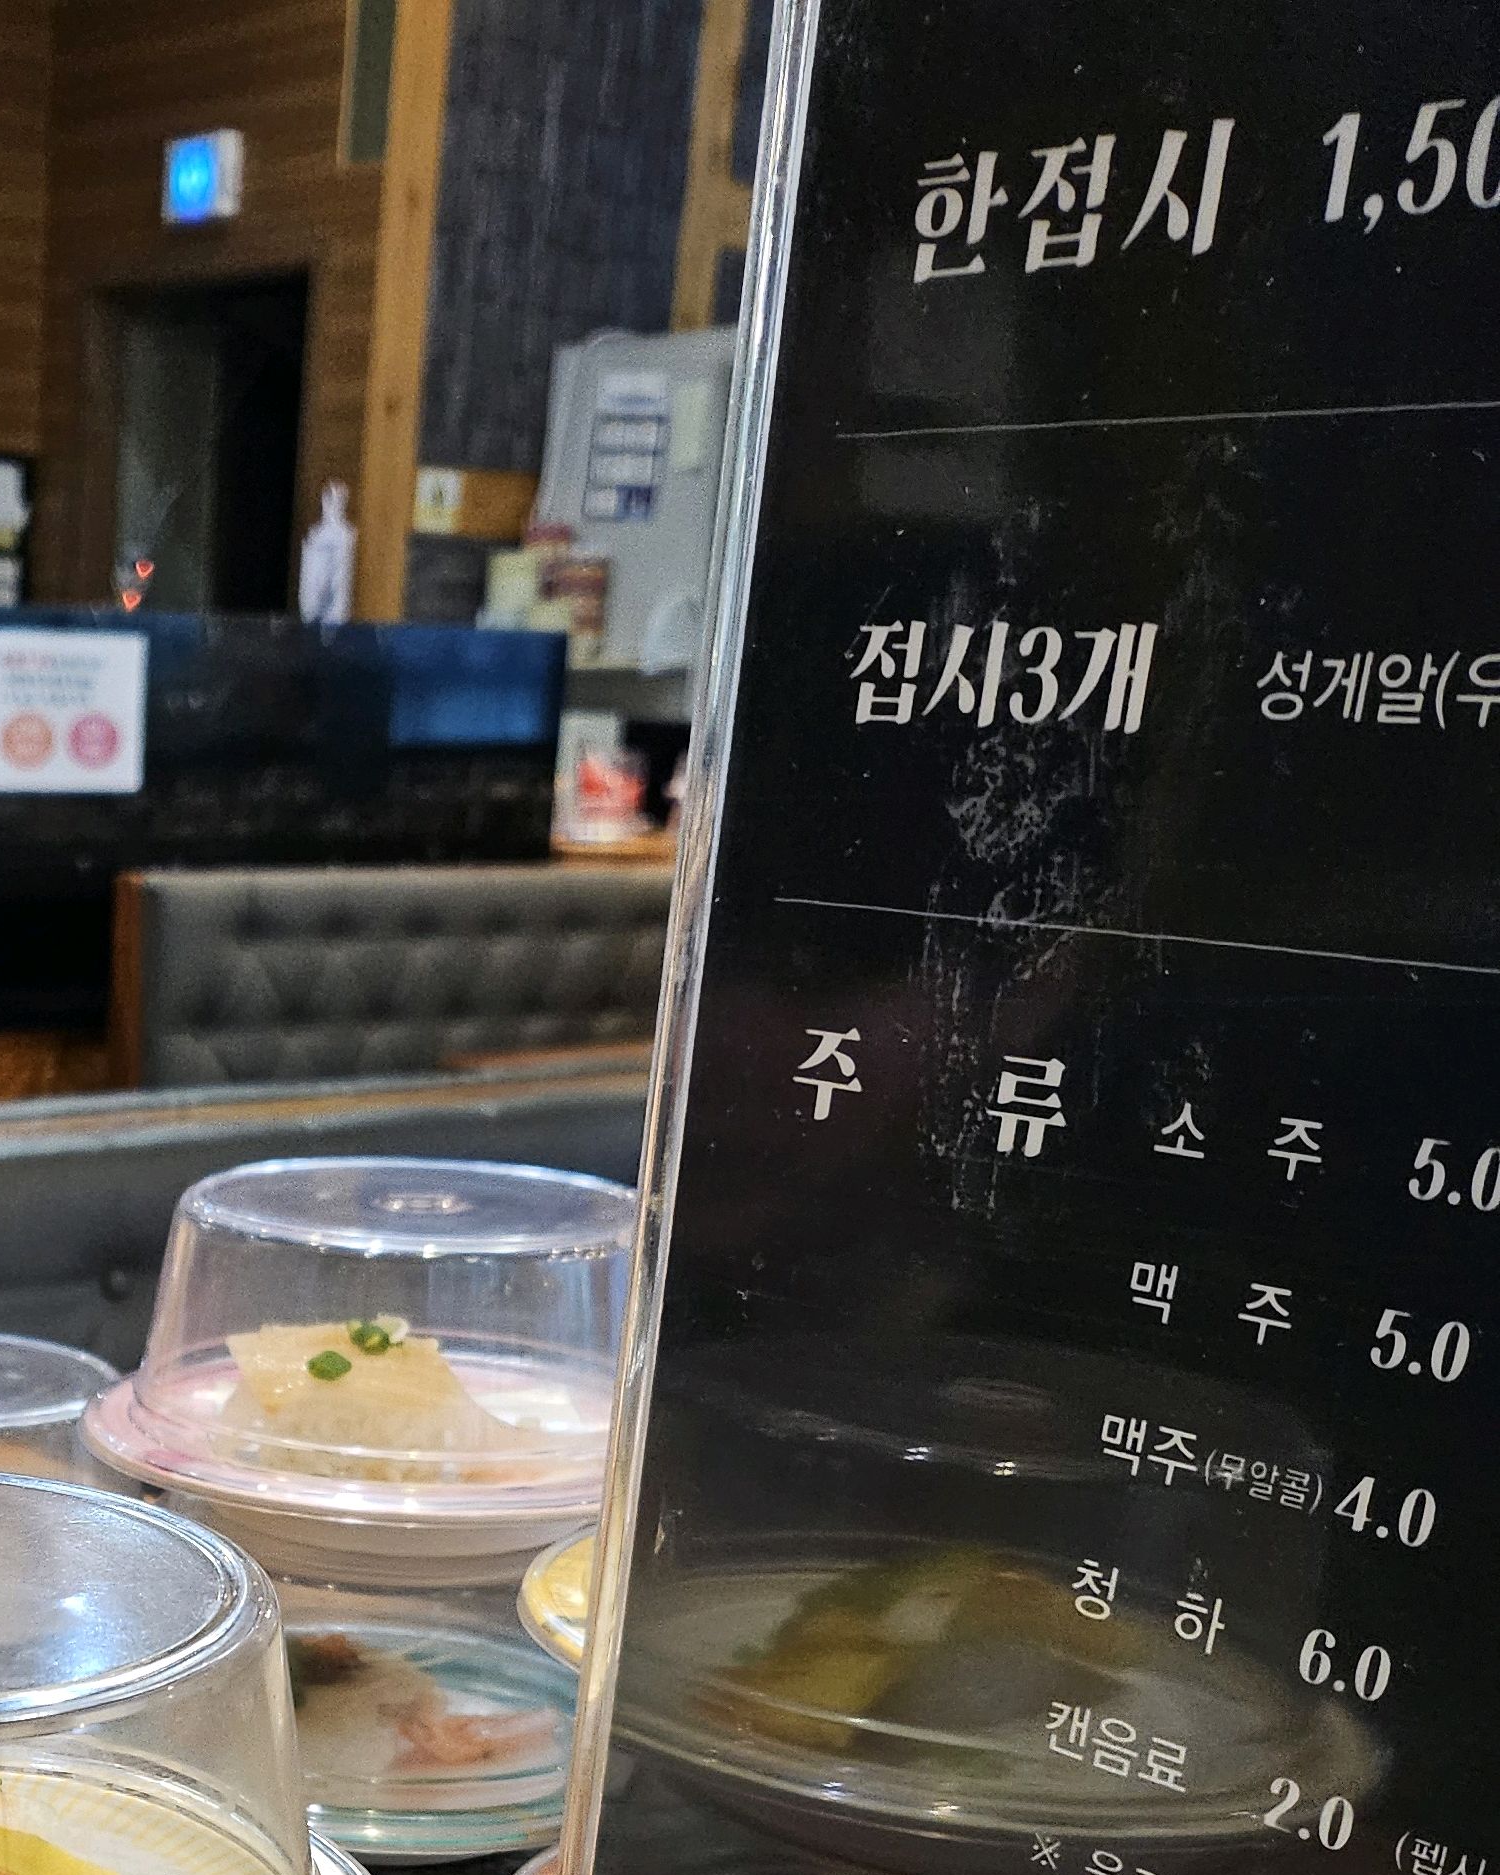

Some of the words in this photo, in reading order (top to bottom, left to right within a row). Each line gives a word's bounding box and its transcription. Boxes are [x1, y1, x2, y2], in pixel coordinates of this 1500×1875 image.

[913, 119, 1235, 284] 한접시
[850, 620, 1158, 734] 접시3개
[1408, 1138, 1500, 1212] 5.0
[1370, 1308, 1470, 1382] 5.0
[1333, 1476, 1436, 1547] 4.0
[1298, 1628, 1392, 1702] 6.0
[1044, 1701, 1188, 1793] 캔음료
[1263, 1777, 1354, 1850] 2.0
